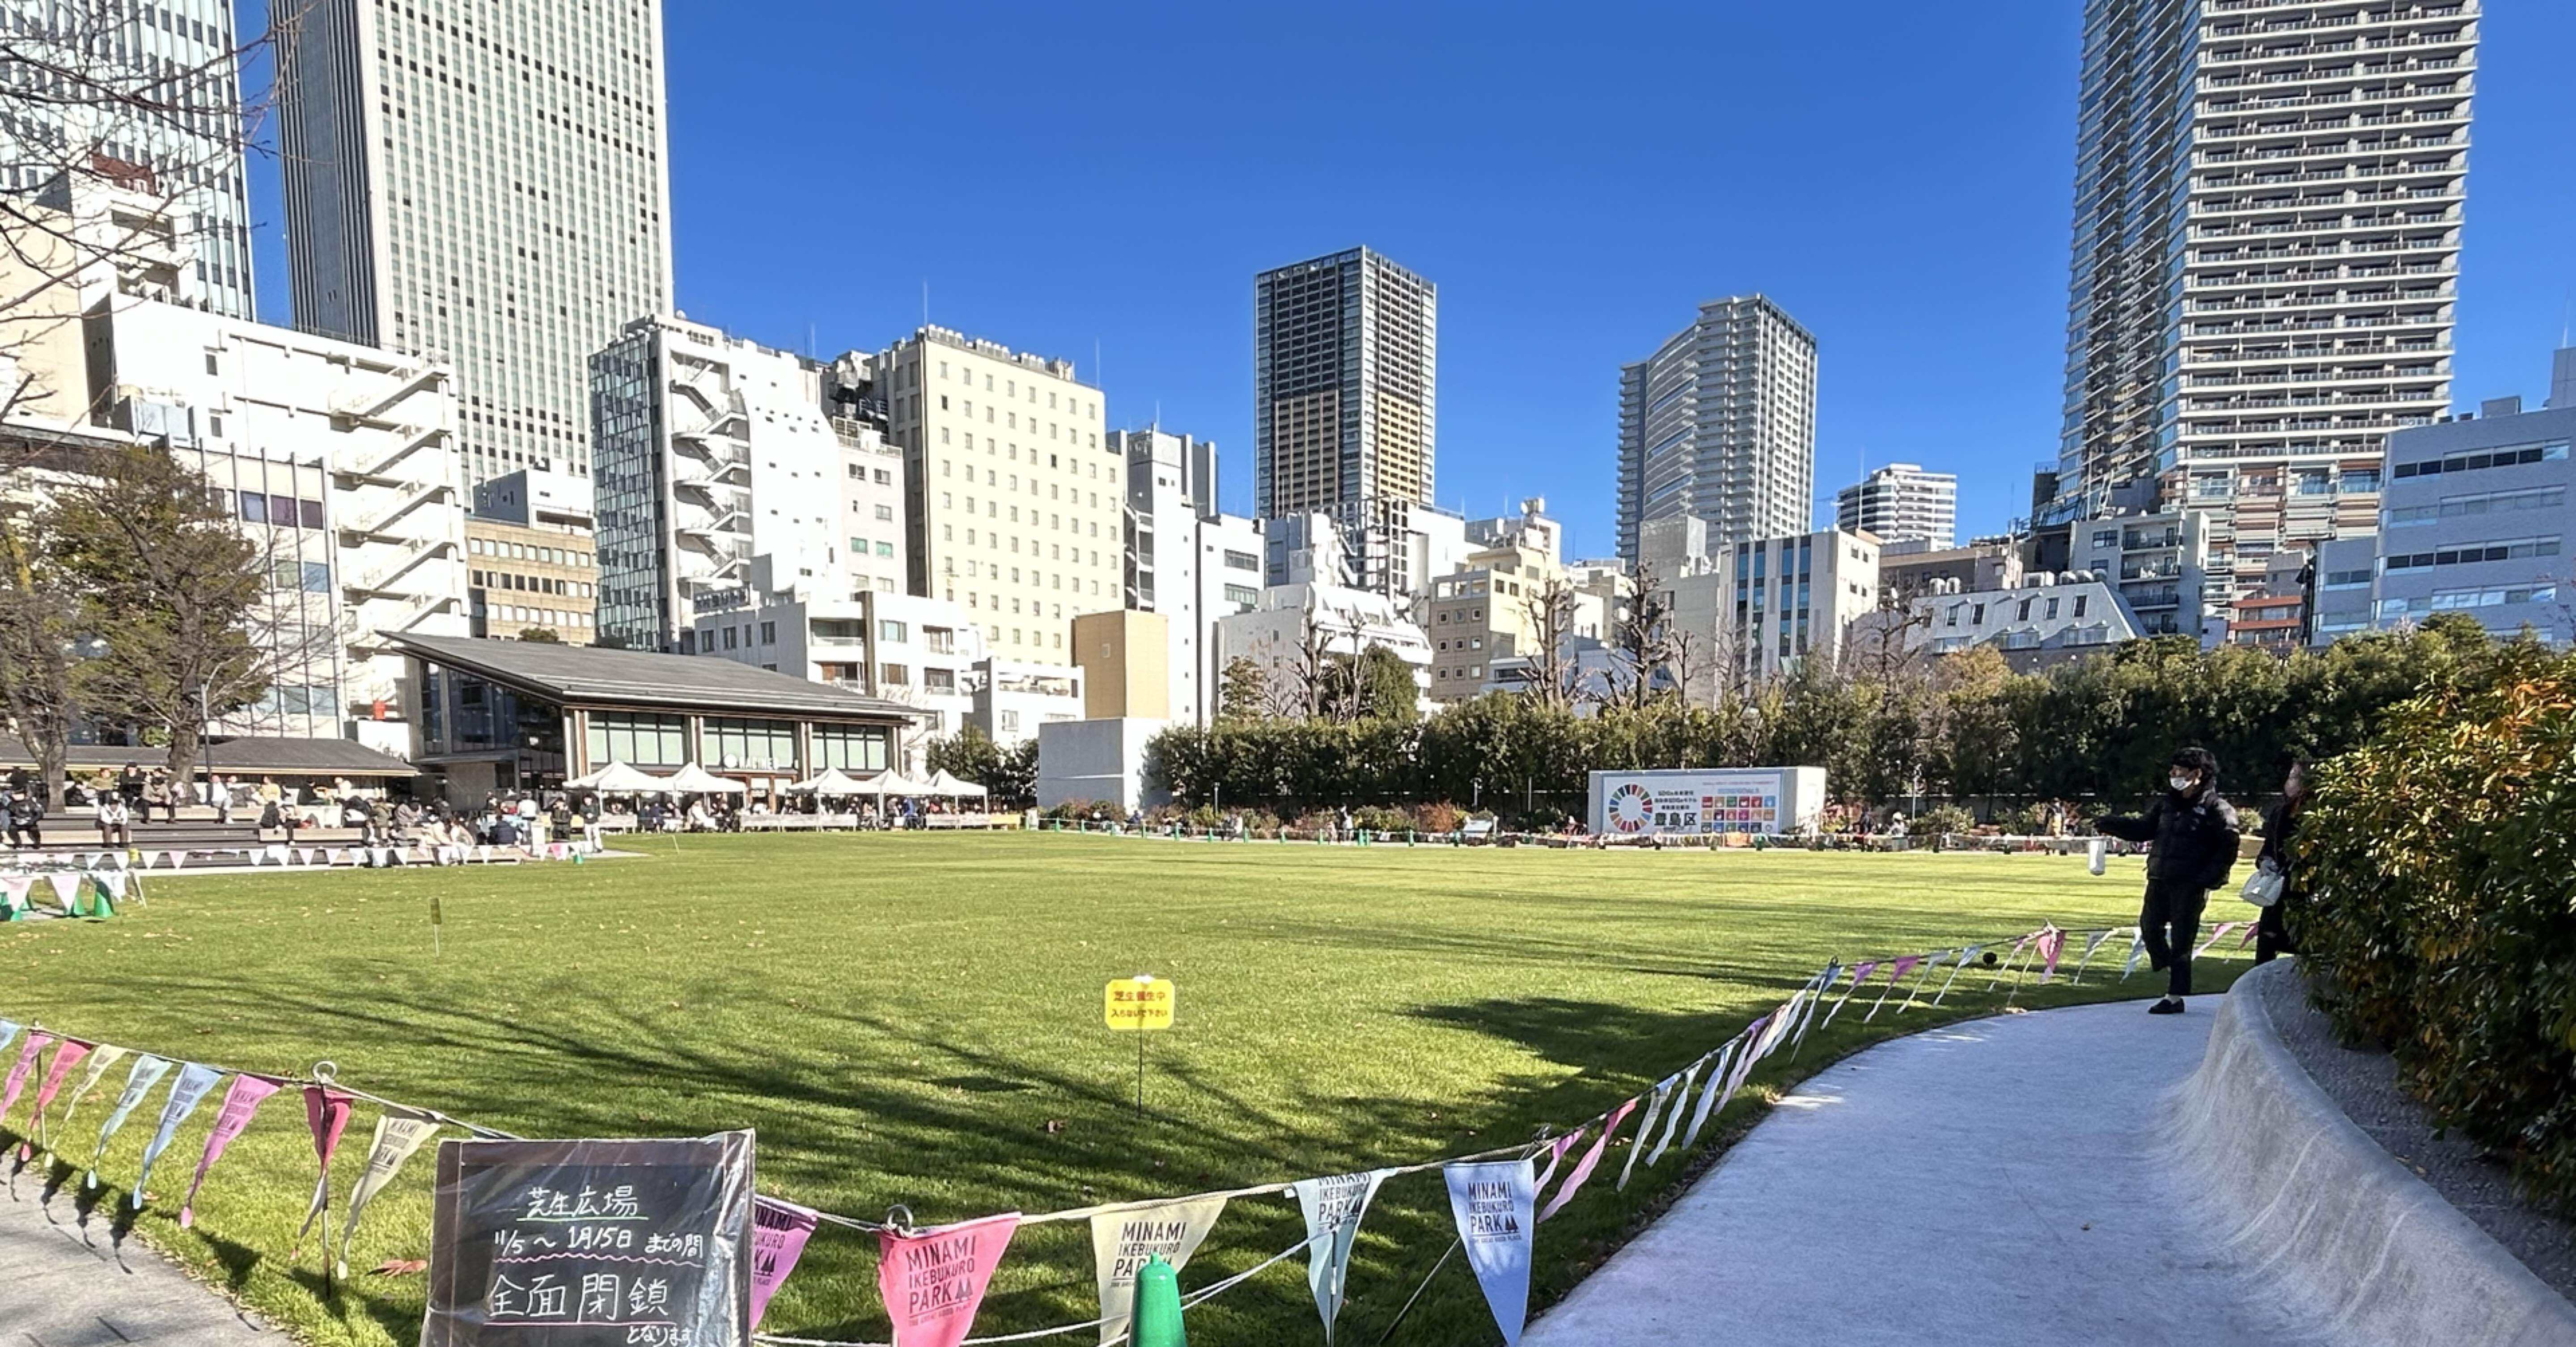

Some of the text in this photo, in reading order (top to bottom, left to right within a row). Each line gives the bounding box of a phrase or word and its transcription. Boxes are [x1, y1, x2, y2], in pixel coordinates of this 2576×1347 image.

[1654, 812, 1697, 826] 豊島区
[527, 1186, 638, 1217] 芝生広場
[1468, 1182, 1512, 1200] MINAMI
[1469, 1200, 1514, 1213] IKEBUKURO
[1121, 1222, 1186, 1241] MINAMI
[1470, 1214, 1503, 1233] PARK
[495, 1230, 525, 1256] 11/5
[567, 1226, 631, 1249] 1月15日
[645, 1233, 703, 1258] までの間
[1119, 1242, 1181, 1256] IKEBUKURO
[906, 1236, 976, 1271] MINAMI
[909, 1258, 974, 1289] IKEBUKURO
[489, 1273, 669, 1323] 全面閉鎖
[910, 1281, 952, 1313] PARK
[627, 1325, 694, 1347] となります
